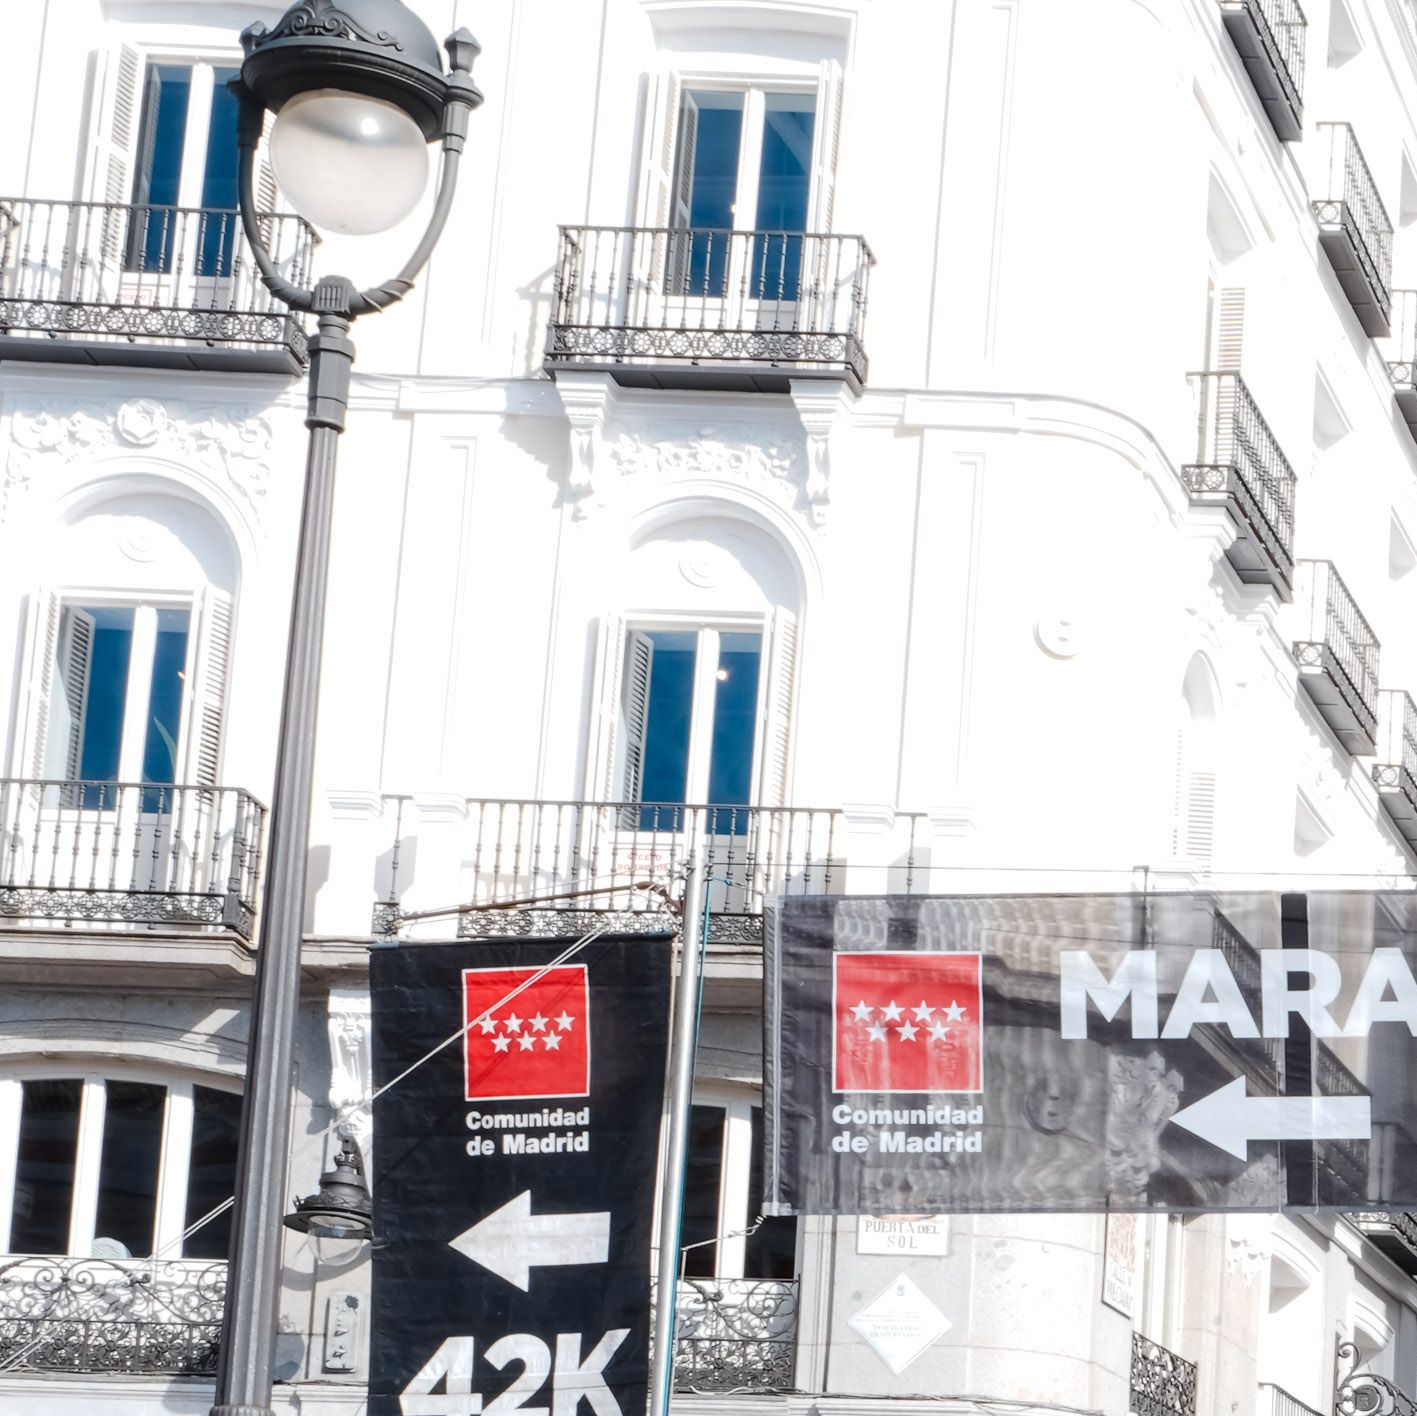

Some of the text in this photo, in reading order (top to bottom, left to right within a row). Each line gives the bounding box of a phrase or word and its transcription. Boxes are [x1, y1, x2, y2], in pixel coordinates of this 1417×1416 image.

[466, 1107, 590, 1130] Comunidad
[832, 1104, 984, 1126] Comunidad
[467, 1131, 590, 1156] de Madrid
[832, 1130, 982, 1154] de Madrid
[865, 1220, 940, 1234] PUERTA DEL
[887, 1236, 917, 1248] SOL
